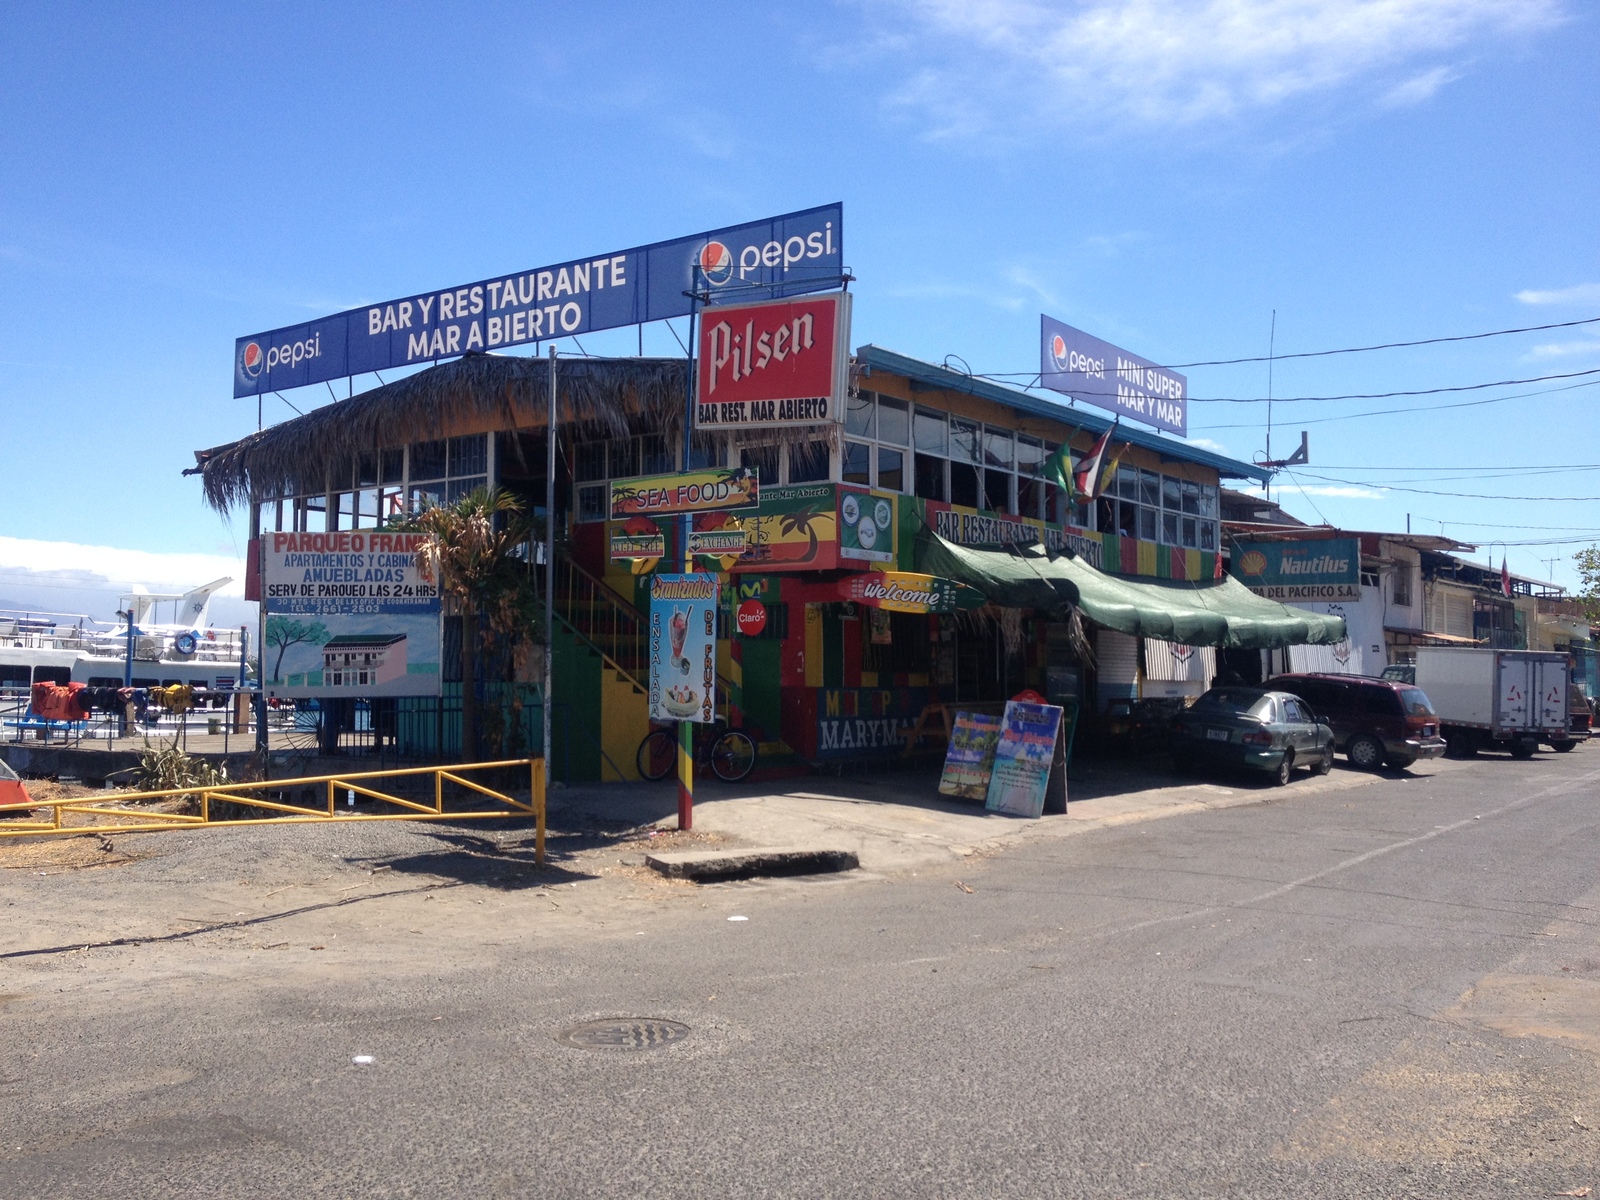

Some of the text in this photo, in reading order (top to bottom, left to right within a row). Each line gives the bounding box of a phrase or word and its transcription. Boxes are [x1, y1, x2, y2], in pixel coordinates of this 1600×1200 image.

[740, 222, 832, 280] pepsi
[368, 255, 627, 336] BAR Y RESTAURANTE
[407, 301, 582, 361] MAR ABIERTO
[266, 331, 320, 374] pepsi
[707, 312, 815, 396] Pilsen
[1069, 350, 1105, 380] pepsi
[1116, 356, 1183, 403] MINI SUPER
[698, 397, 828, 424] BAR REST. MAR ABIERTO
[1117, 384, 1182, 428] MAR Y MAR
[636, 482, 730, 509] SEA FOOD
[780, 490, 795, 499] Mar
[798, 488, 829, 498] Abierto
[935, 511, 960, 544] BAR
[962, 514, 1040, 544] RESTAURANTE
[274, 533, 364, 553] PARQUEO
[702, 536, 742, 549] EXCHANGE
[284, 554, 419, 568] APARTAMENTOS Y CABINA
[1279, 556, 1350, 575] Nautilus
[303, 568, 405, 583] AMUEBLADAS
[301, 584, 315, 597] DE
[318, 584, 366, 597] PARQUEO
[369, 584, 390, 597] LAS
[393, 584, 414, 597] 24
[416, 585, 437, 597] HRS
[863, 582, 940, 606] Welcome
[1268, 586, 1286, 598] DEL
[1288, 585, 1335, 598] PACIFICO
[1337, 585, 1357, 597] S.A.
[739, 613, 761, 623] Claro
